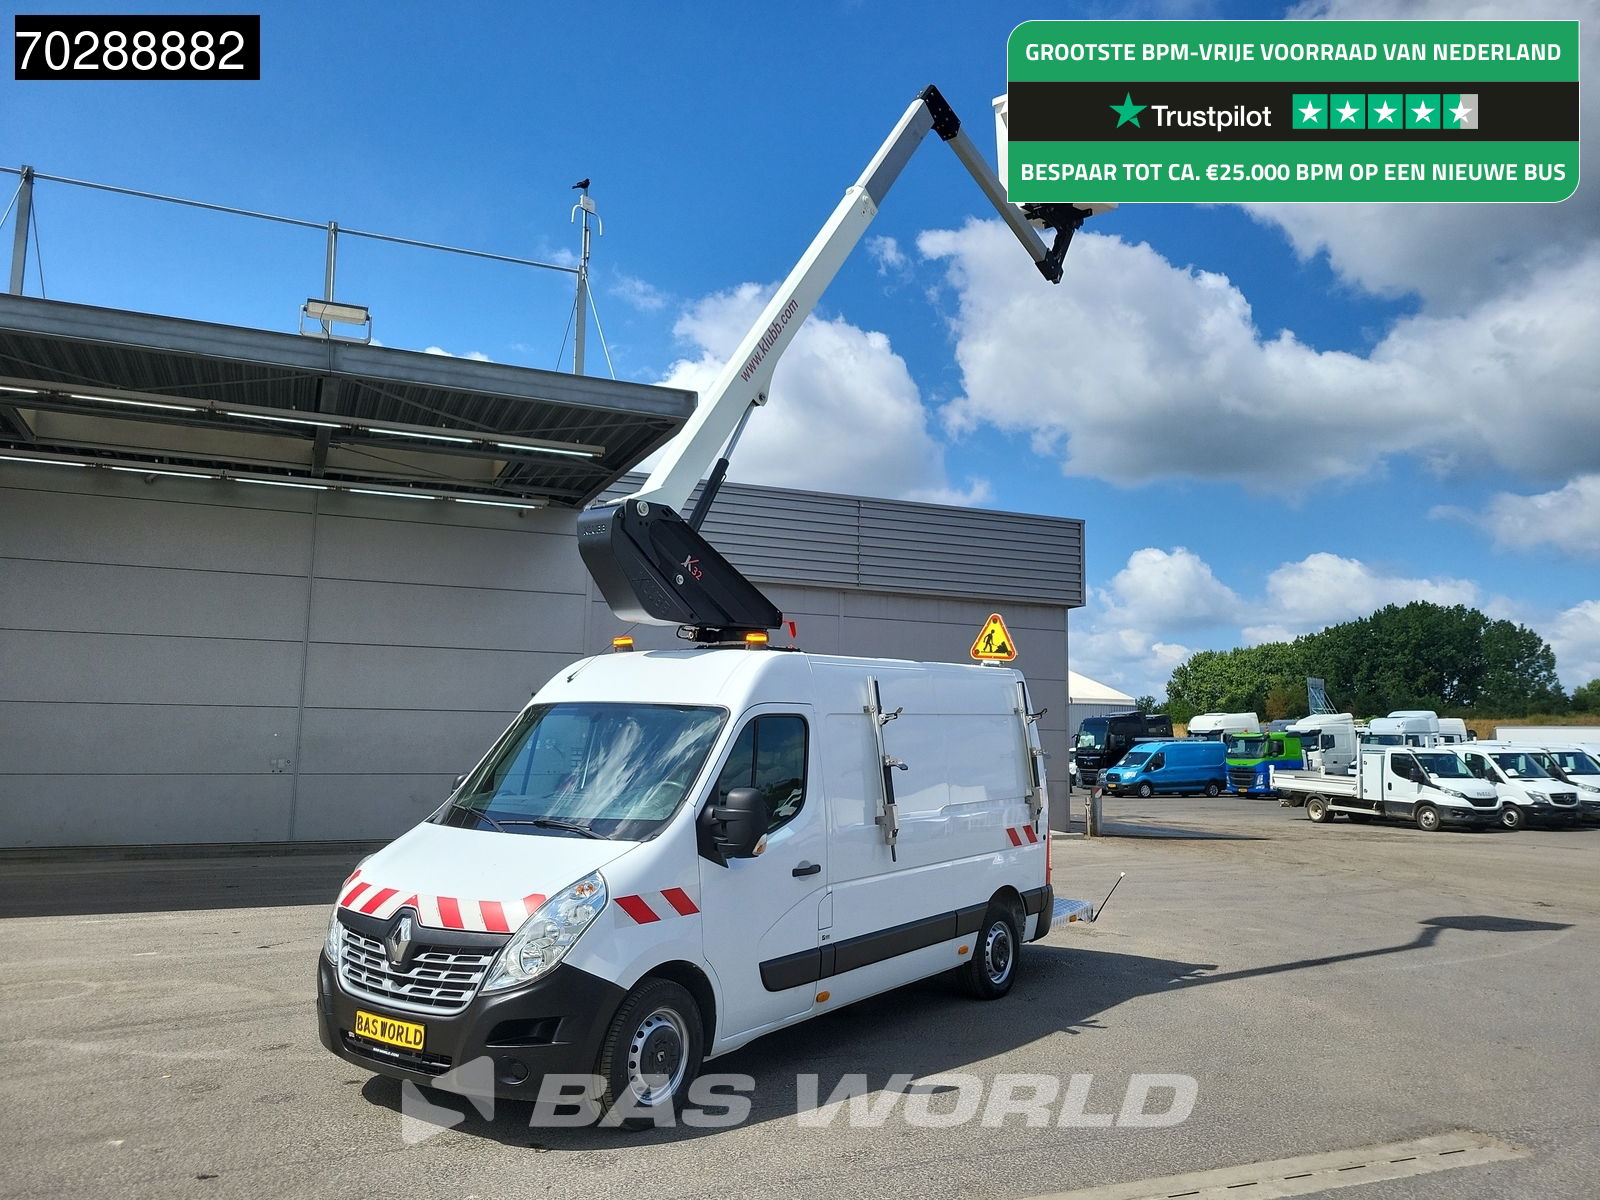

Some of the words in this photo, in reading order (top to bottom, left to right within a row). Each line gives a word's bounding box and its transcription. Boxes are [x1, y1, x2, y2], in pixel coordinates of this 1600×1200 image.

[740, 299, 799, 382] www.klubb.com
[357, 1014, 379, 1036] BAS
[380, 1020, 423, 1046] WORLD
